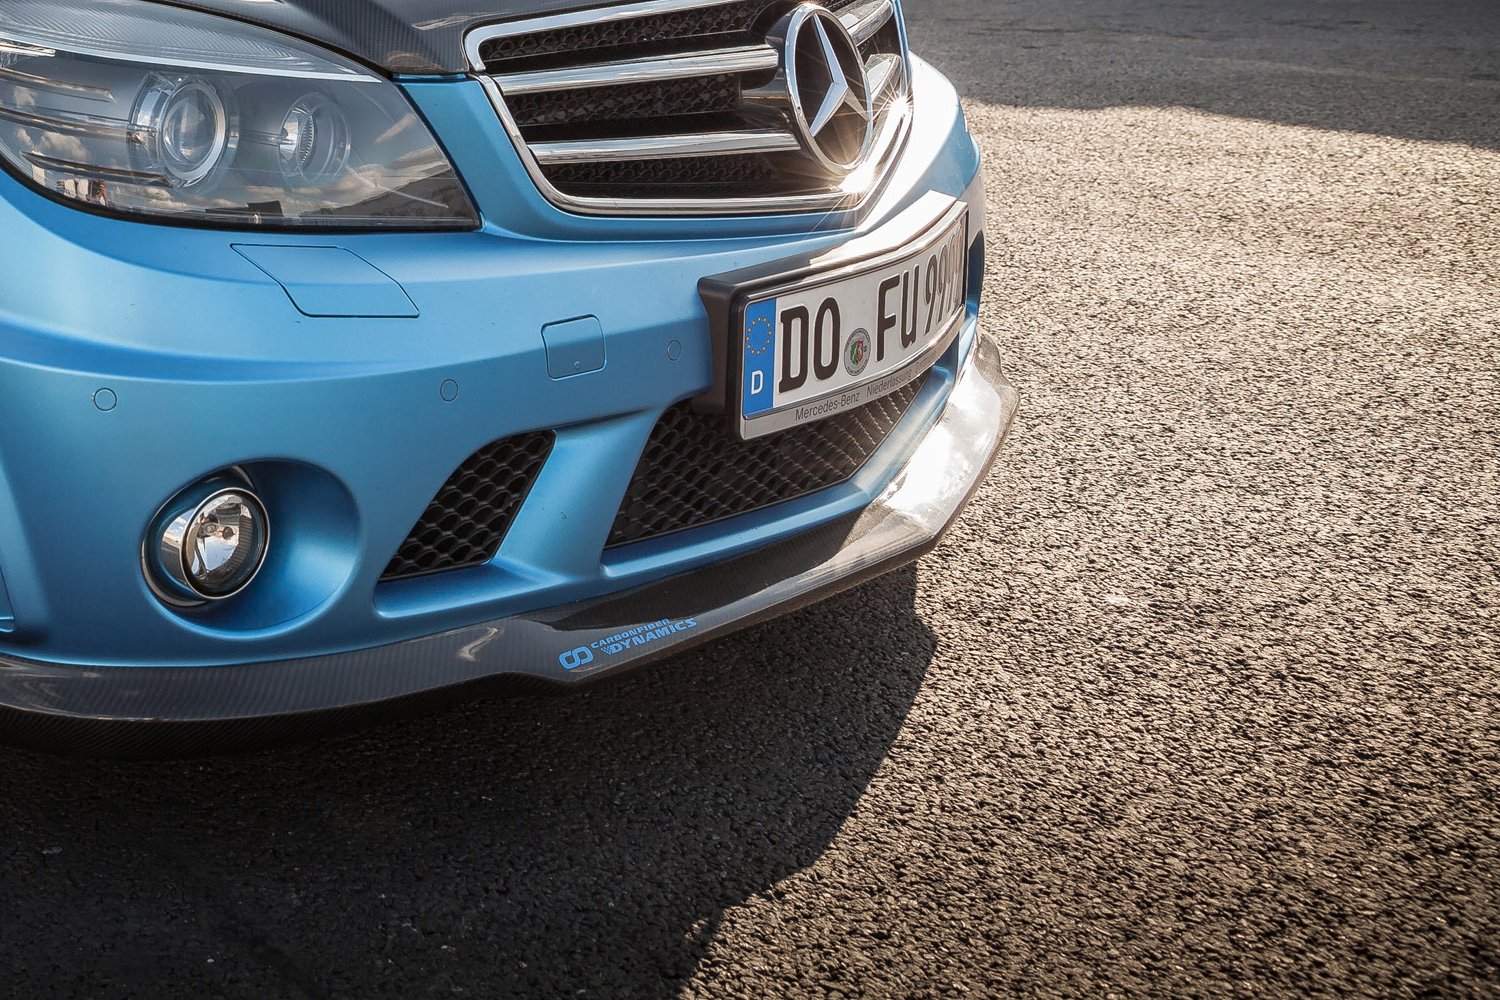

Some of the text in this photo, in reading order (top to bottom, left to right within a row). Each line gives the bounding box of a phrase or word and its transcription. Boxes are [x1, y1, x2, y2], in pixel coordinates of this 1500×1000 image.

[778, 296, 841, 394] DO
[876, 263, 919, 362] FU
[750, 369, 764, 395] D
[795, 391, 860, 421] Mercedes-Benz
[590, 618, 671, 650] CARBONFIBER
[610, 617, 698, 655] DYNAMICS
